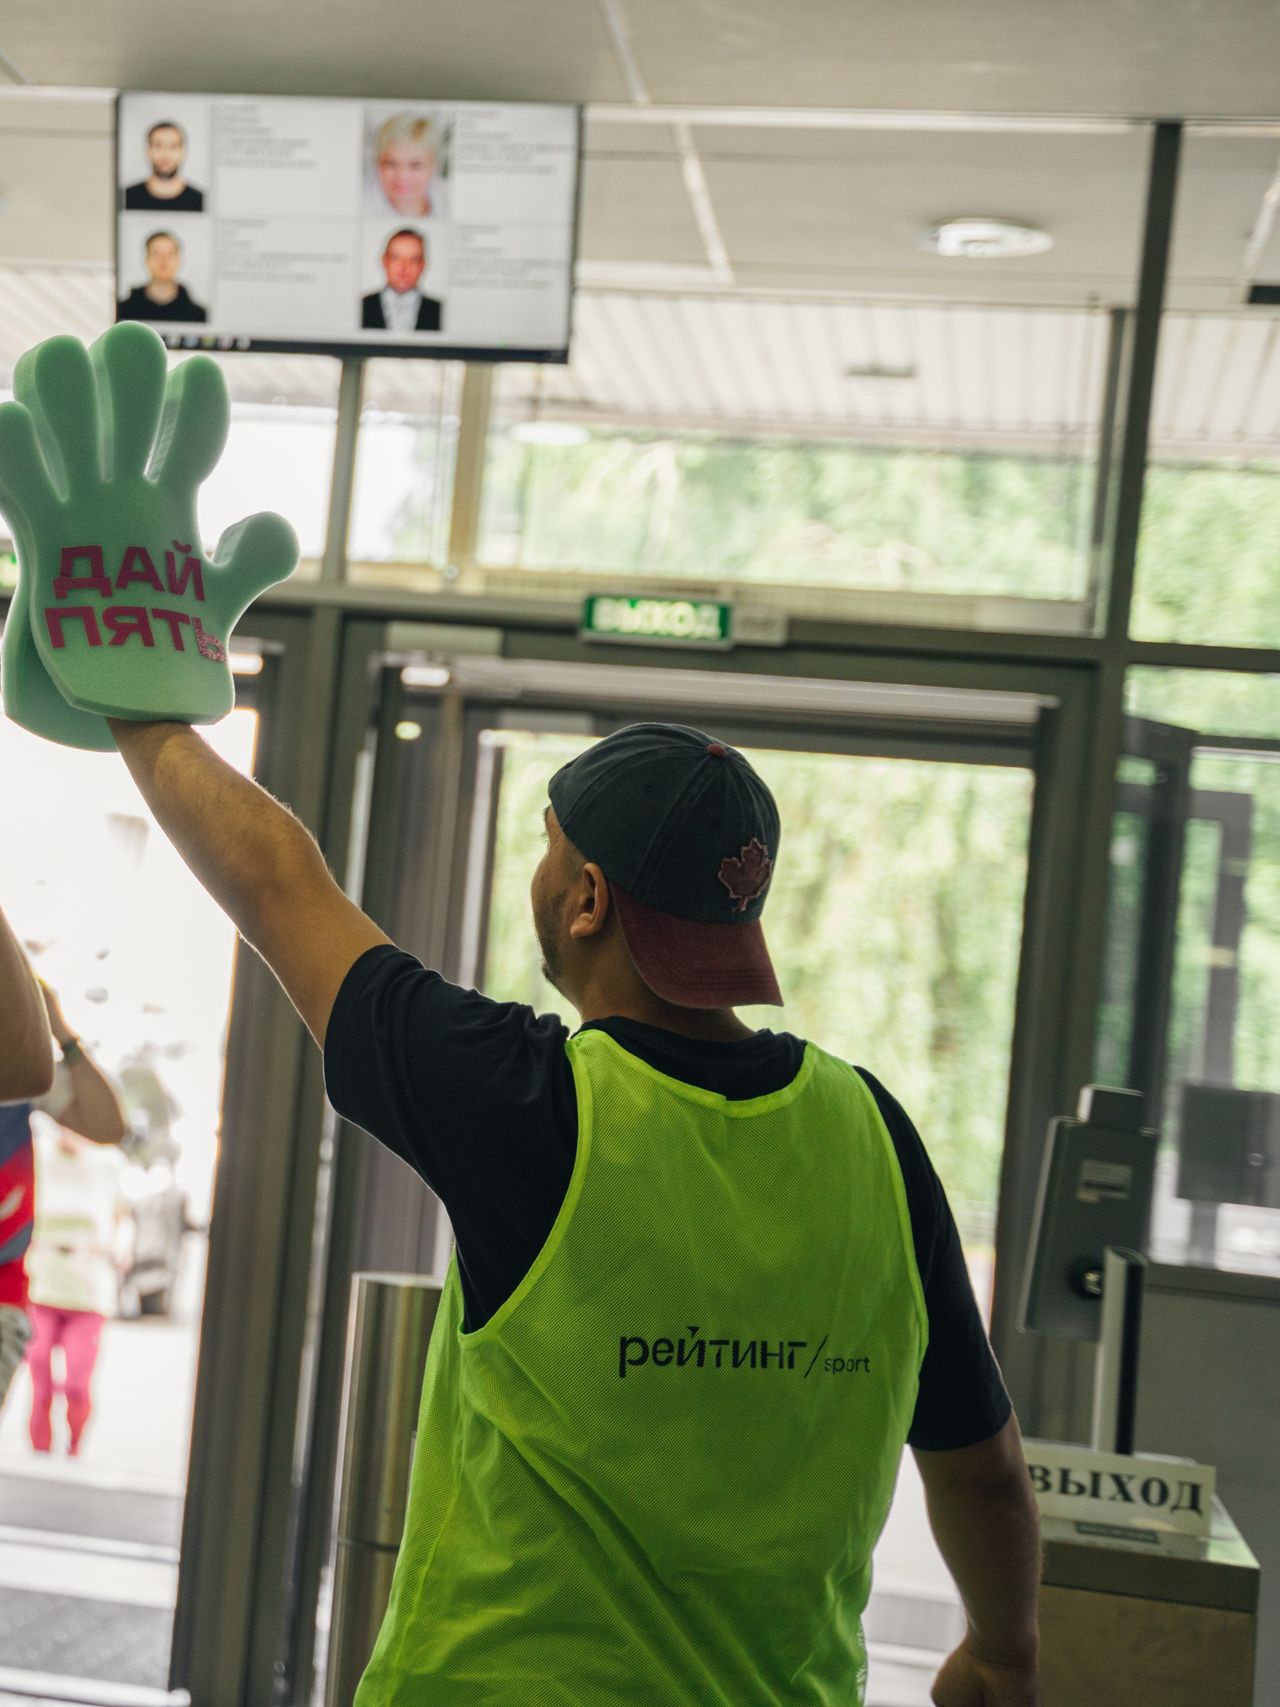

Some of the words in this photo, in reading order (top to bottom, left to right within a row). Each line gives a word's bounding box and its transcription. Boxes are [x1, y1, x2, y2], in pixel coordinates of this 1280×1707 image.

[52, 539, 206, 602] ДАЙ
[43, 605, 228, 663] ПЯТЬ
[1028, 1463, 1204, 1516] ВЫХОД
